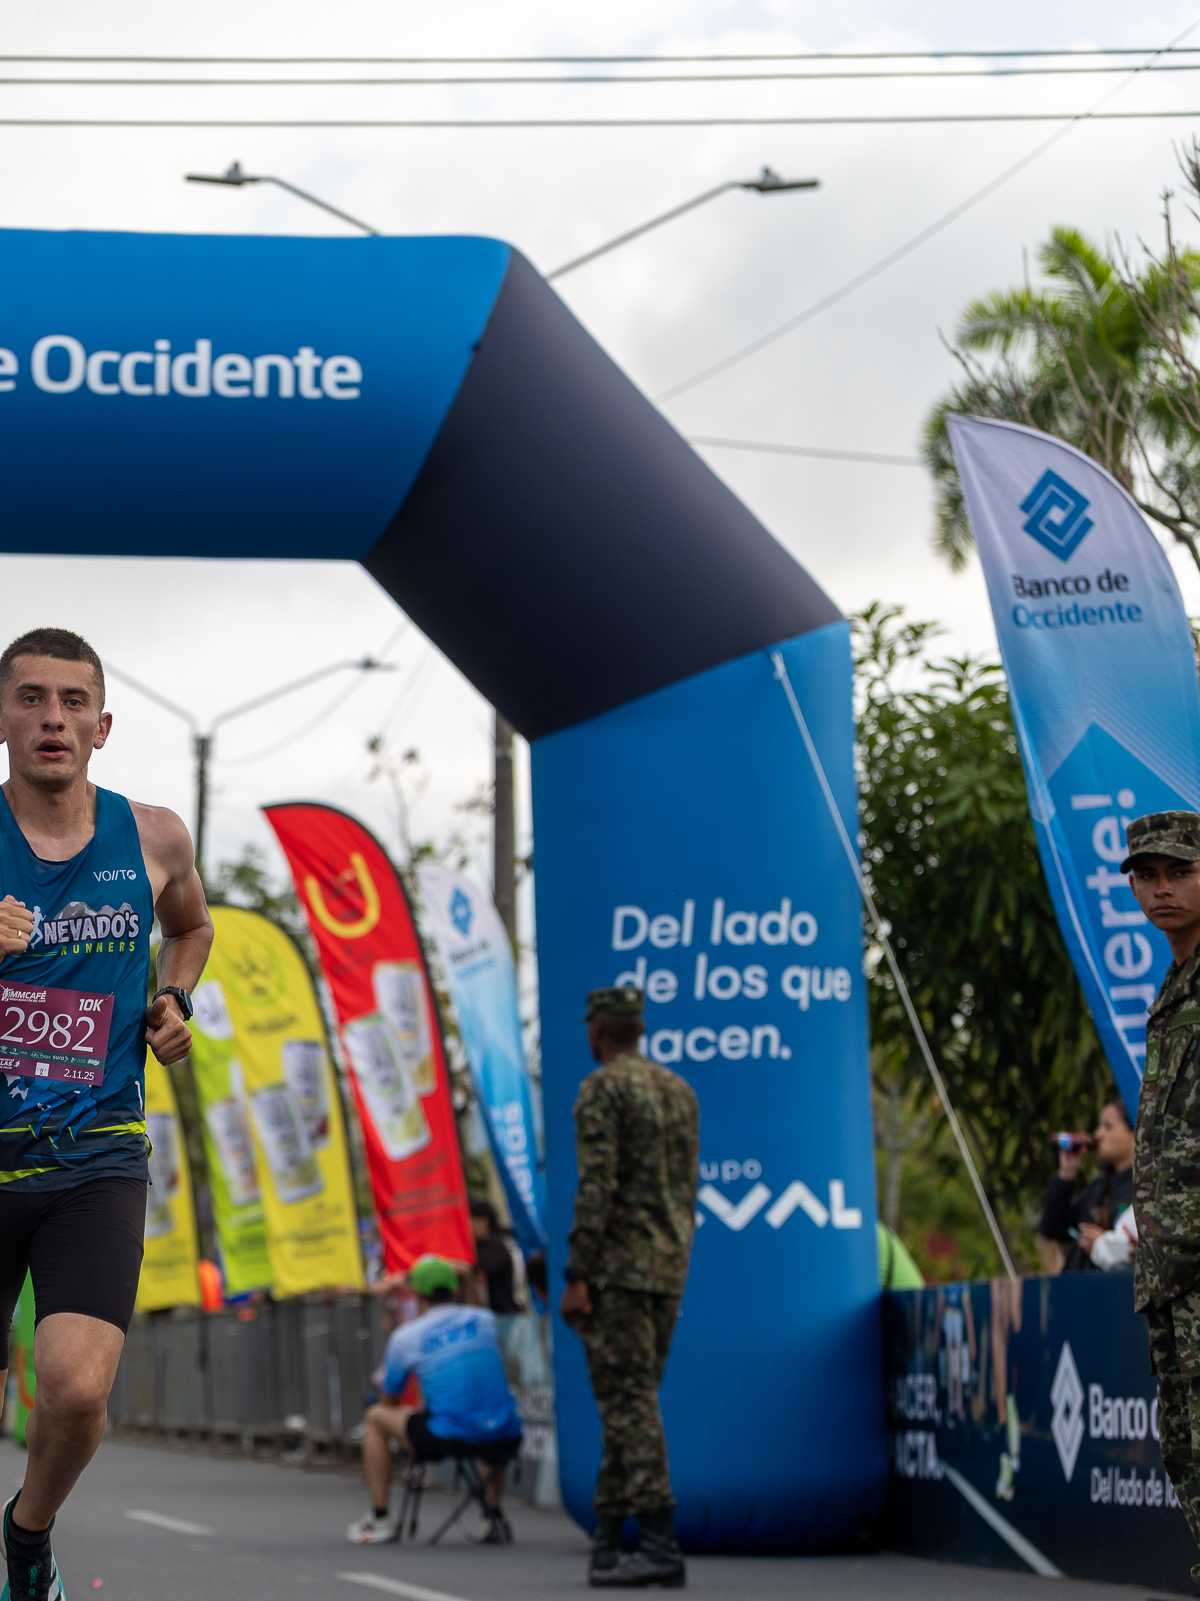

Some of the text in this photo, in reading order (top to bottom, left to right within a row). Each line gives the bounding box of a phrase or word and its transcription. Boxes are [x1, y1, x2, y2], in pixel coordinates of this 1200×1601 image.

[30, 333, 364, 400] Occidente
[1011, 567, 1130, 599] Banco de
[1011, 600, 1144, 629] Occidente
[43, 911, 140, 945] NEVADO'S
[611, 896, 819, 951] Del lado
[61, 941, 136, 956] RUNNERS
[613, 951, 853, 1013] de los que
[79, 998, 104, 1012] 10K
[0, 1006, 96, 1053] 2982
[638, 1024, 793, 1064] acen.
[64, 1068, 95, 1081] 2.11.25
[695, 1178, 863, 1232] VAL
[1088, 1382, 1148, 1440] Banco
[1090, 1466, 1113, 1504] Del
[1114, 1466, 1144, 1507] lado
[1145, 1467, 1163, 1507] de
